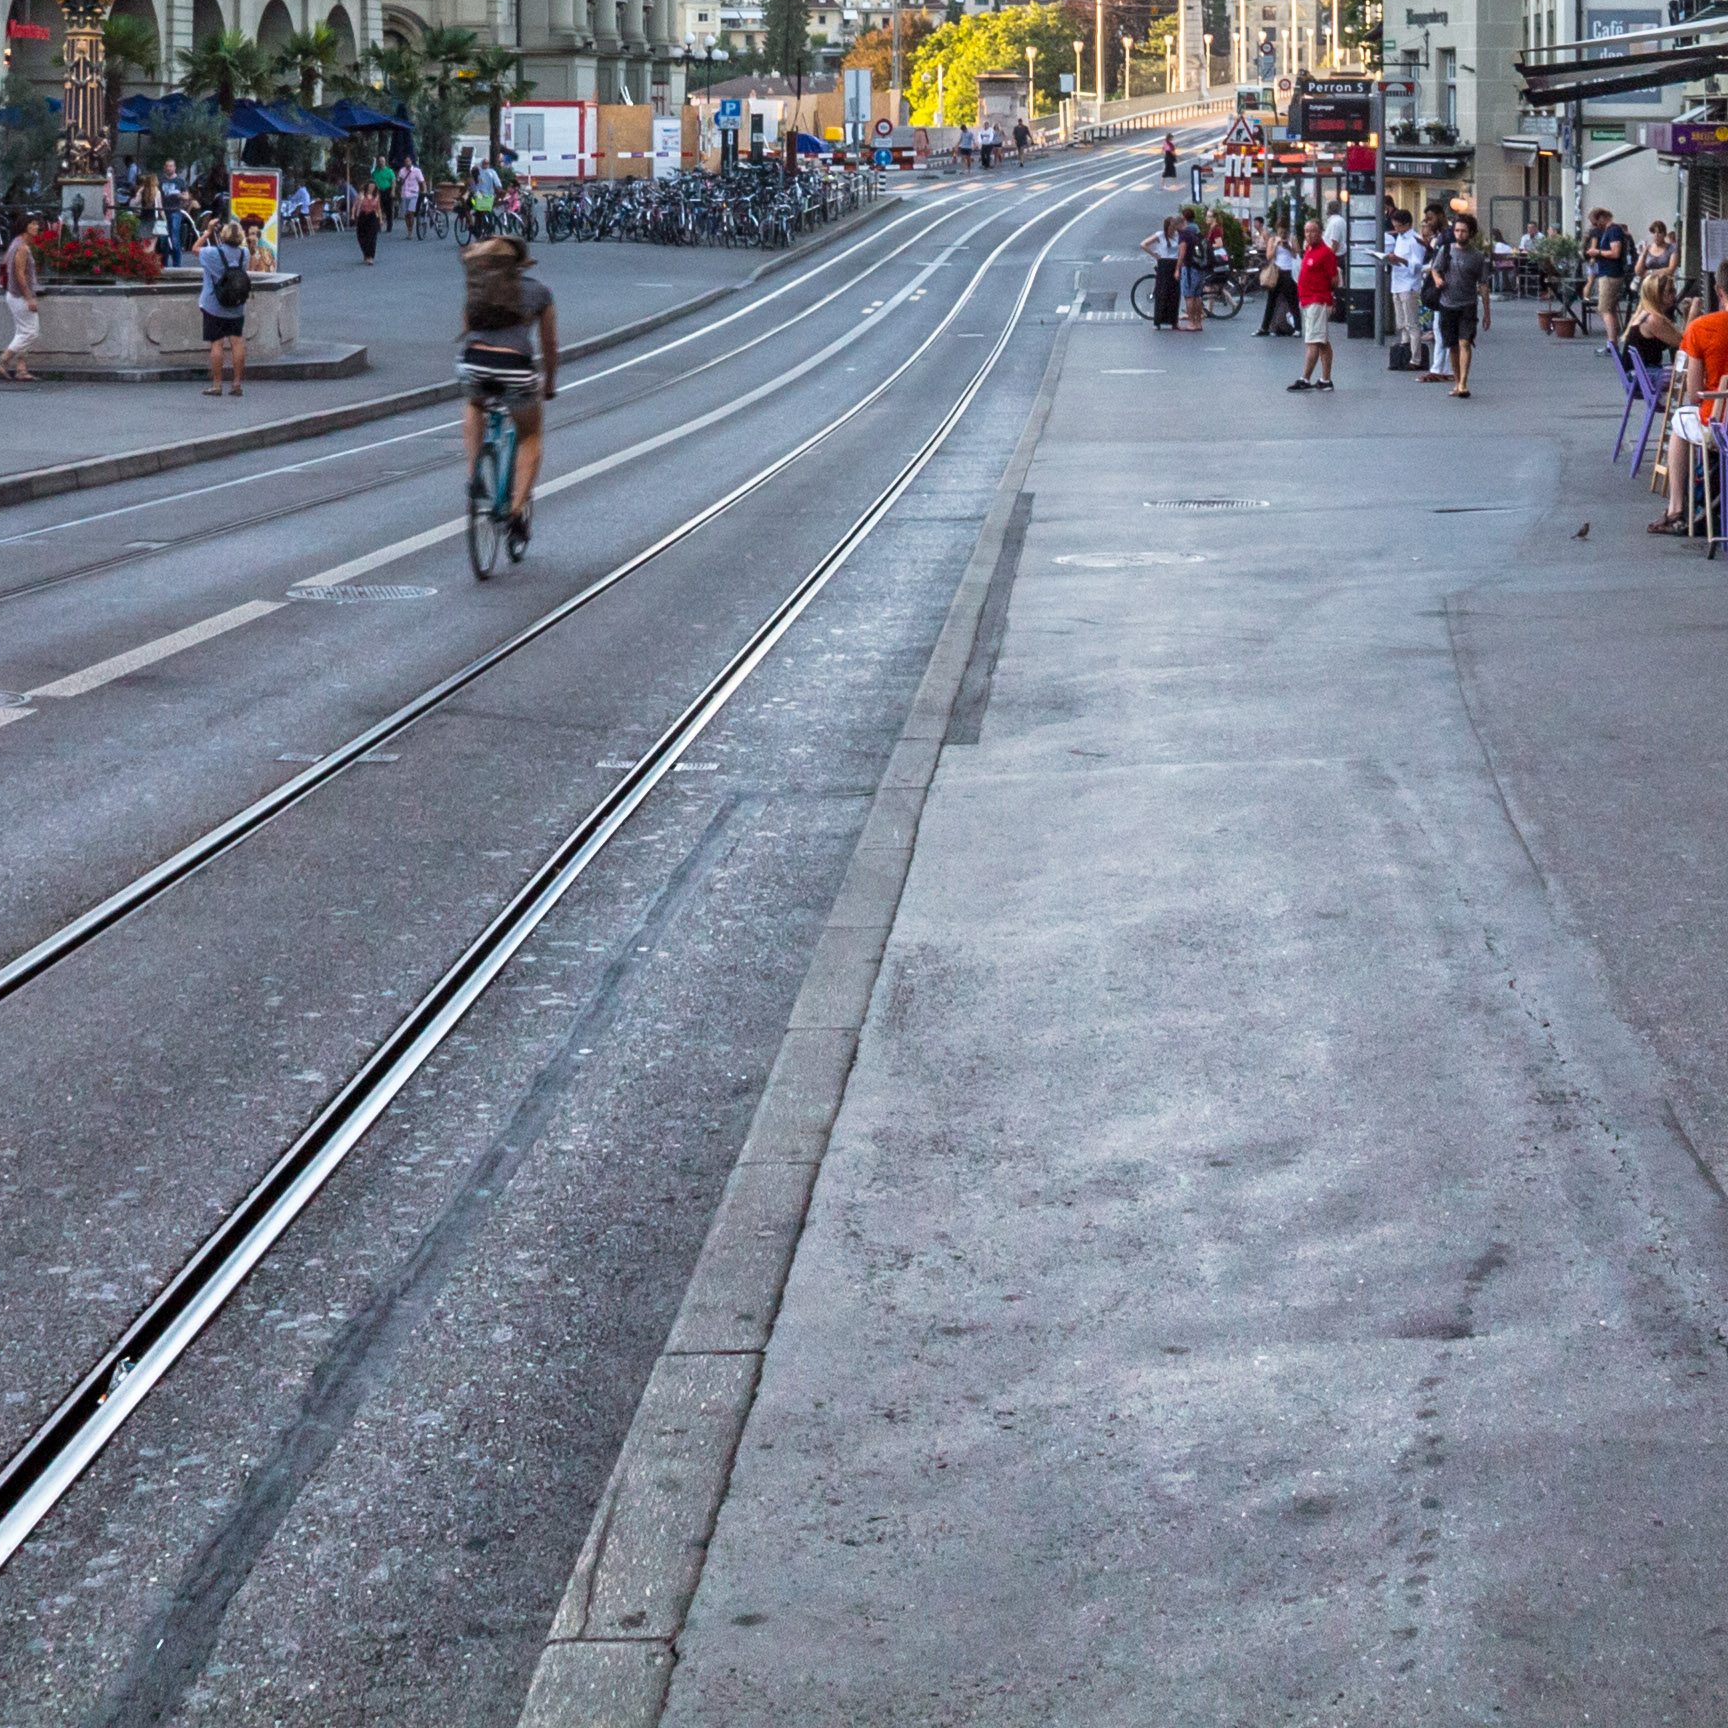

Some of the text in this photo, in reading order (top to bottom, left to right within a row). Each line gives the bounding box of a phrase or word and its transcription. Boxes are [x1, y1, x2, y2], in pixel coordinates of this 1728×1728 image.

[1593, 20, 1624, 39] Café
[1308, 82, 1364, 93] Perron S
[725, 101, 737, 117] P
